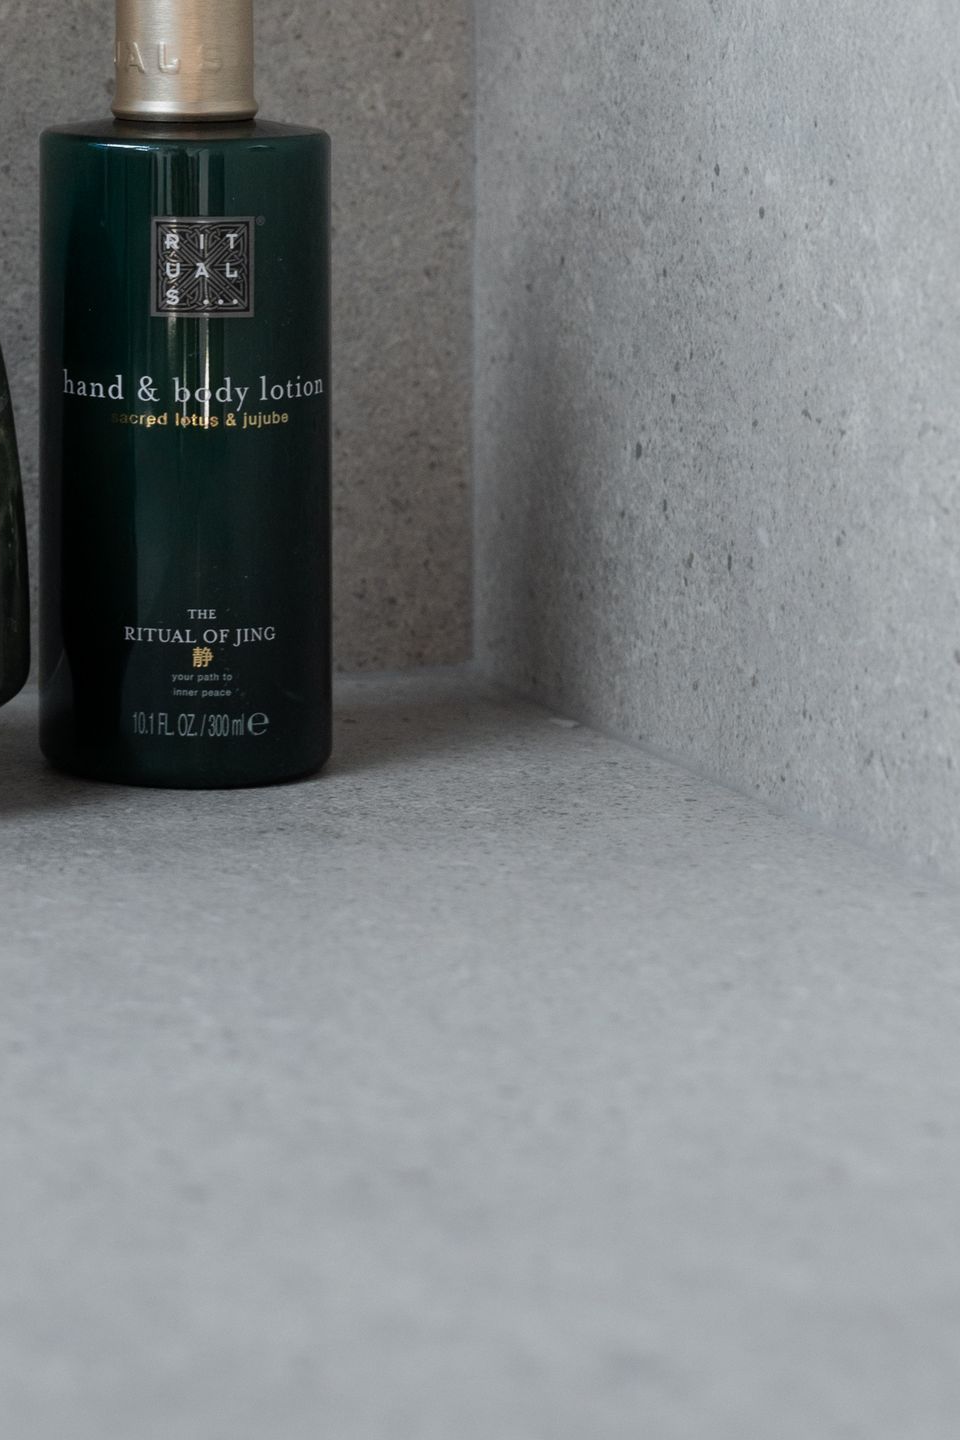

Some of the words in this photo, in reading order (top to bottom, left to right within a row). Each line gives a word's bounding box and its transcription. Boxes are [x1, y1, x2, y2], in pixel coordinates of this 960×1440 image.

[62, 368, 125, 400] hand
[137, 375, 160, 402] &
[172, 376, 249, 412] body
[259, 375, 323, 401] lotion
[111, 412, 168, 426] sacred
[175, 412, 219, 427] lotus
[225, 412, 237, 427] &
[242, 411, 289, 429] jujube
[187, 609, 217, 620] THE
[124, 626, 197, 643] RITUAL
[203, 629, 230, 644] OF
[233, 626, 276, 647] JING
[192, 646, 214, 668] 静
[171, 673, 194, 682] your
[197, 672, 220, 683] path
[222, 673, 233, 681] to
[173, 688, 198, 697] inner
[201, 689, 232, 698] peace
[132, 711, 154, 735] 10.1
[177, 713, 198, 737] OZ.
